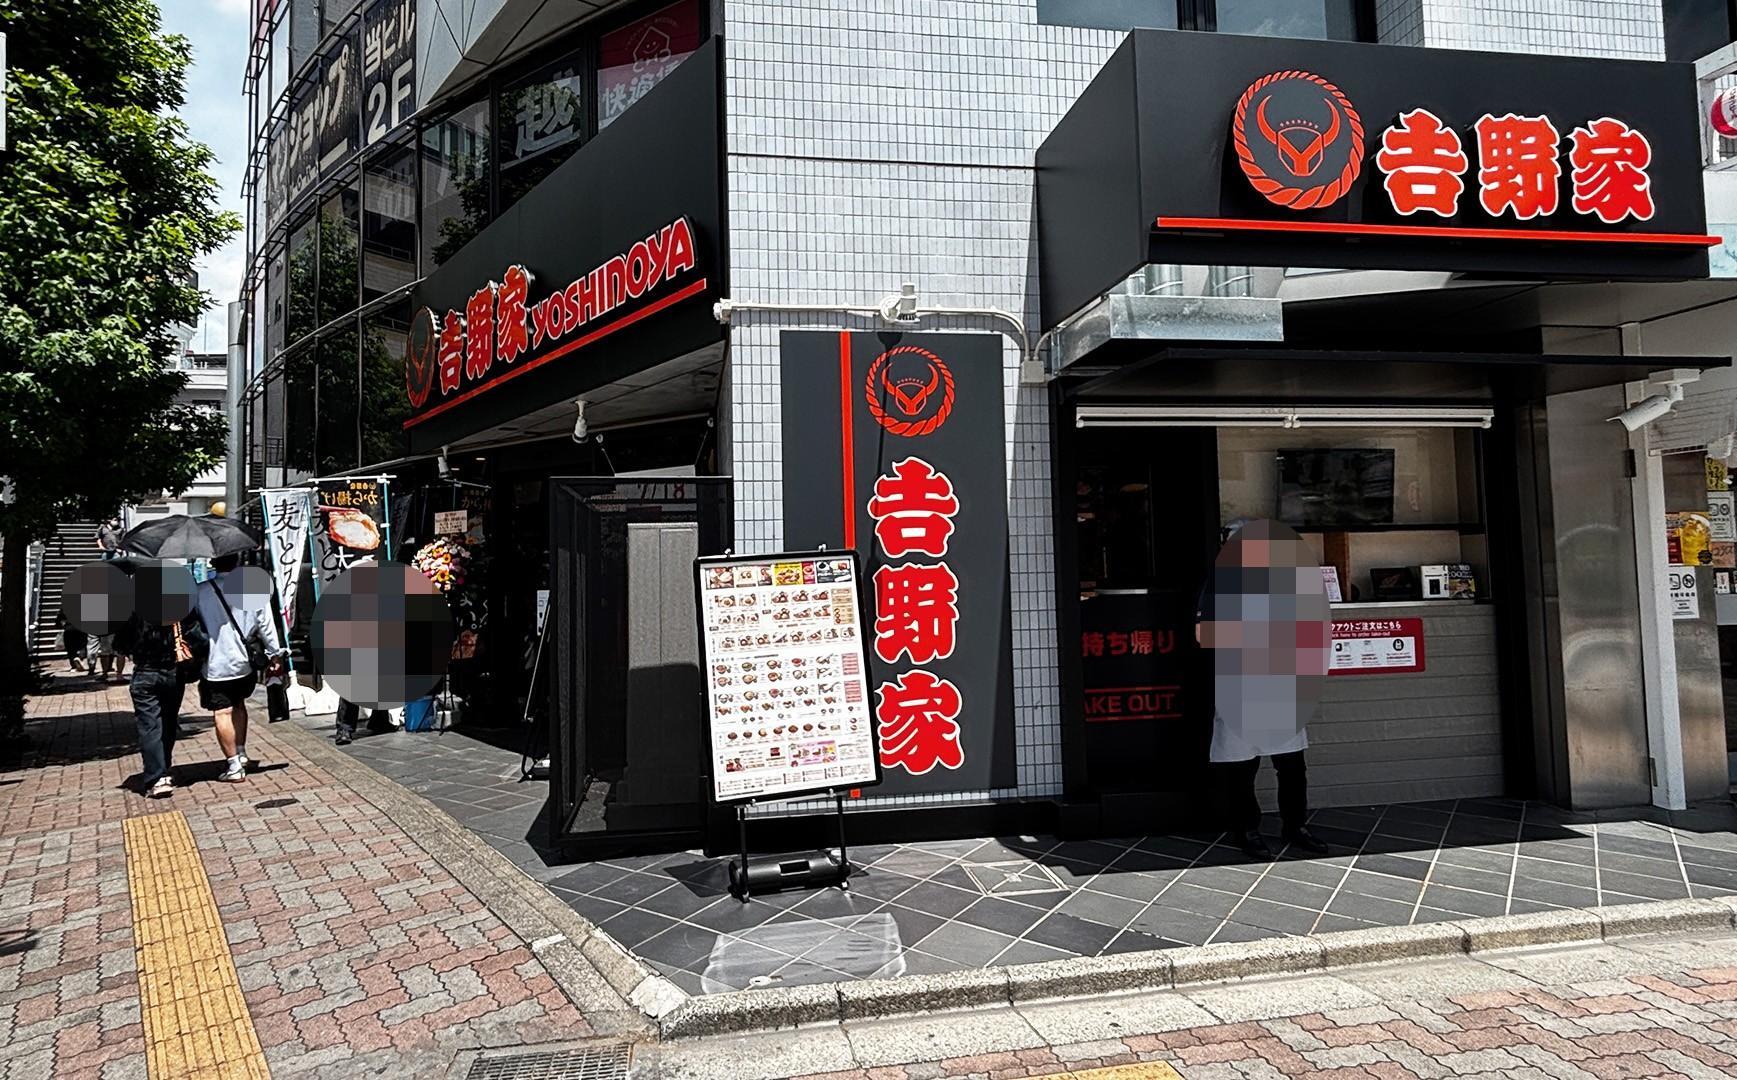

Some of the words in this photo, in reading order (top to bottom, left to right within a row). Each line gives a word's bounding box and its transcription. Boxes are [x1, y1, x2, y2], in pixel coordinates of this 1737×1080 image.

[364, 0, 416, 77] 当ビル
[367, 58, 413, 146] 2F
[1376, 107, 1656, 224] 吉野家
[438, 264, 529, 396] 吉野家
[531, 216, 695, 350] YOSHINOYA
[867, 456, 965, 776] 吉野家
[1082, 630, 1175, 657] 持ち帰り
[1128, 692, 1175, 711] OUT
